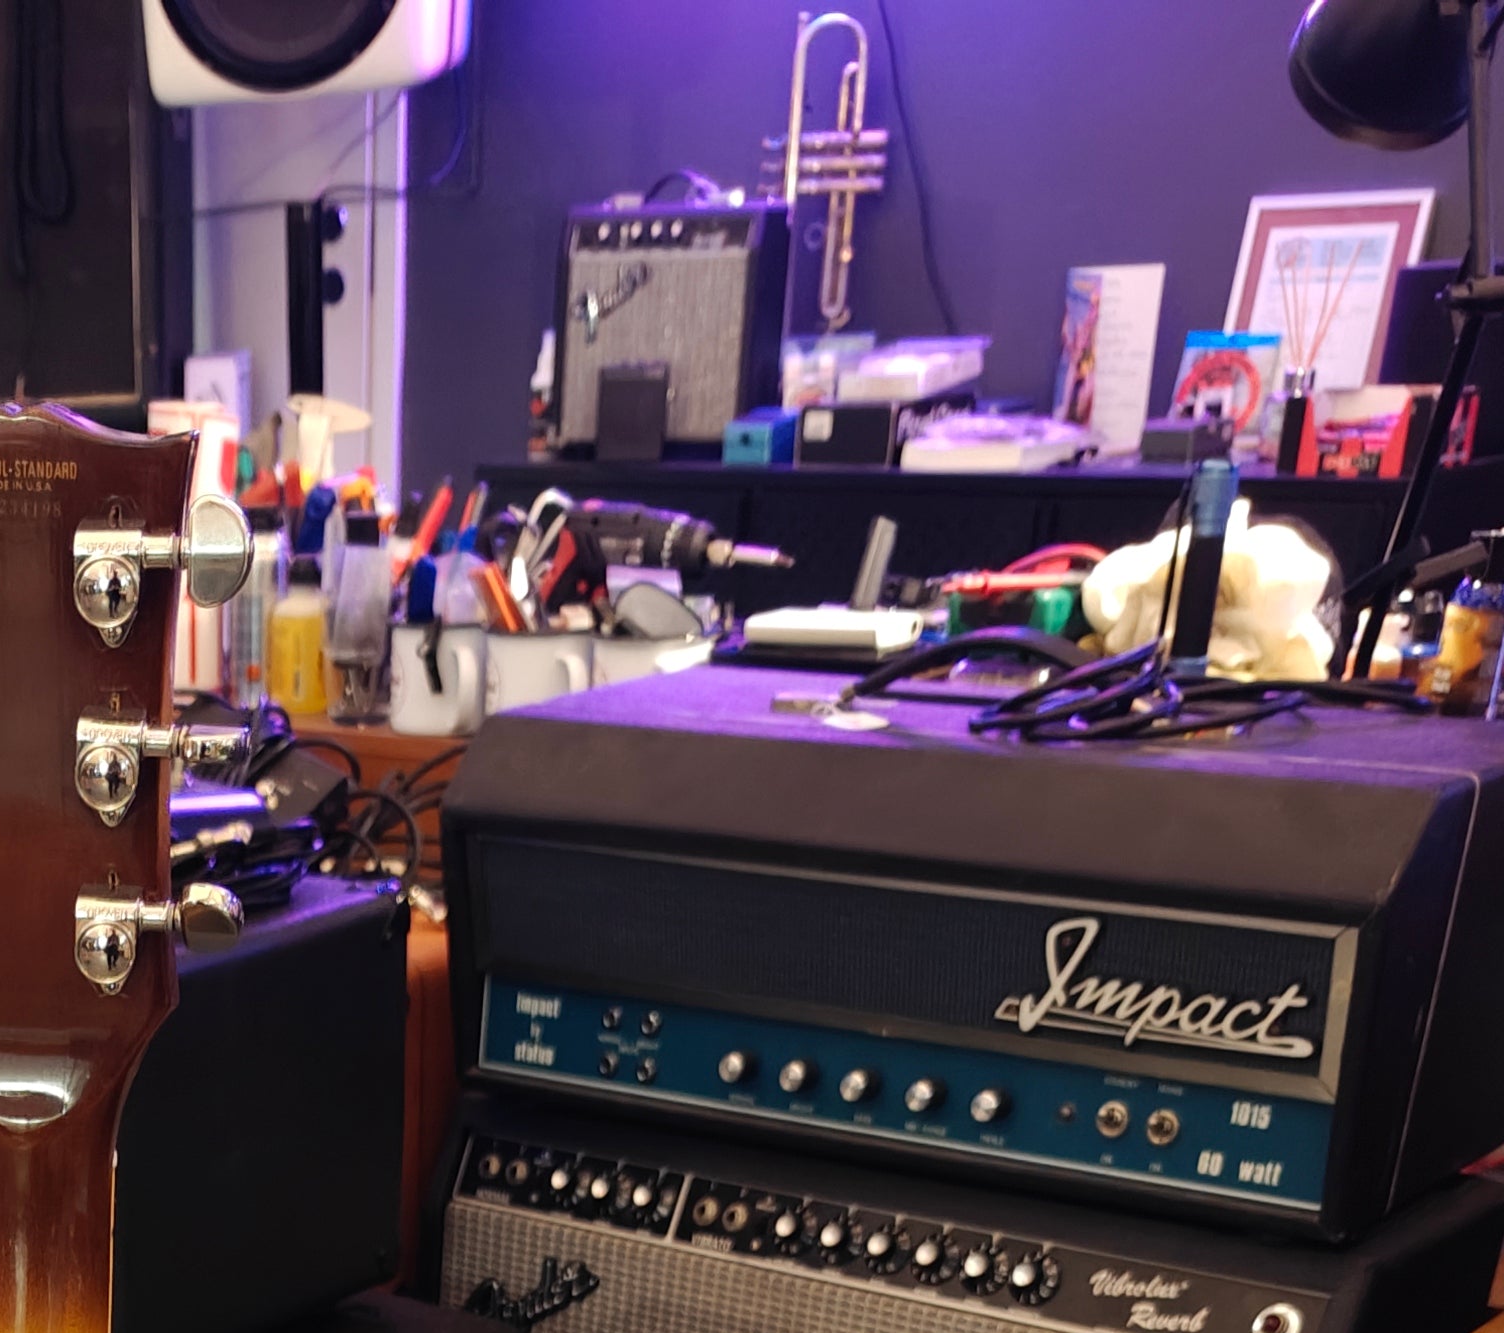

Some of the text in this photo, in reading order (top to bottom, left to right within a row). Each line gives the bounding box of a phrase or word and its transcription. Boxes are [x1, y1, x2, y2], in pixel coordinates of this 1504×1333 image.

[12, 481, 23, 491] IN
[1014, 917, 1313, 1058] Impact
[1230, 1100, 1273, 1130] 1015
[1197, 1150, 1283, 1187] 60 watt
[1126, 1301, 1212, 1333] Reverb
